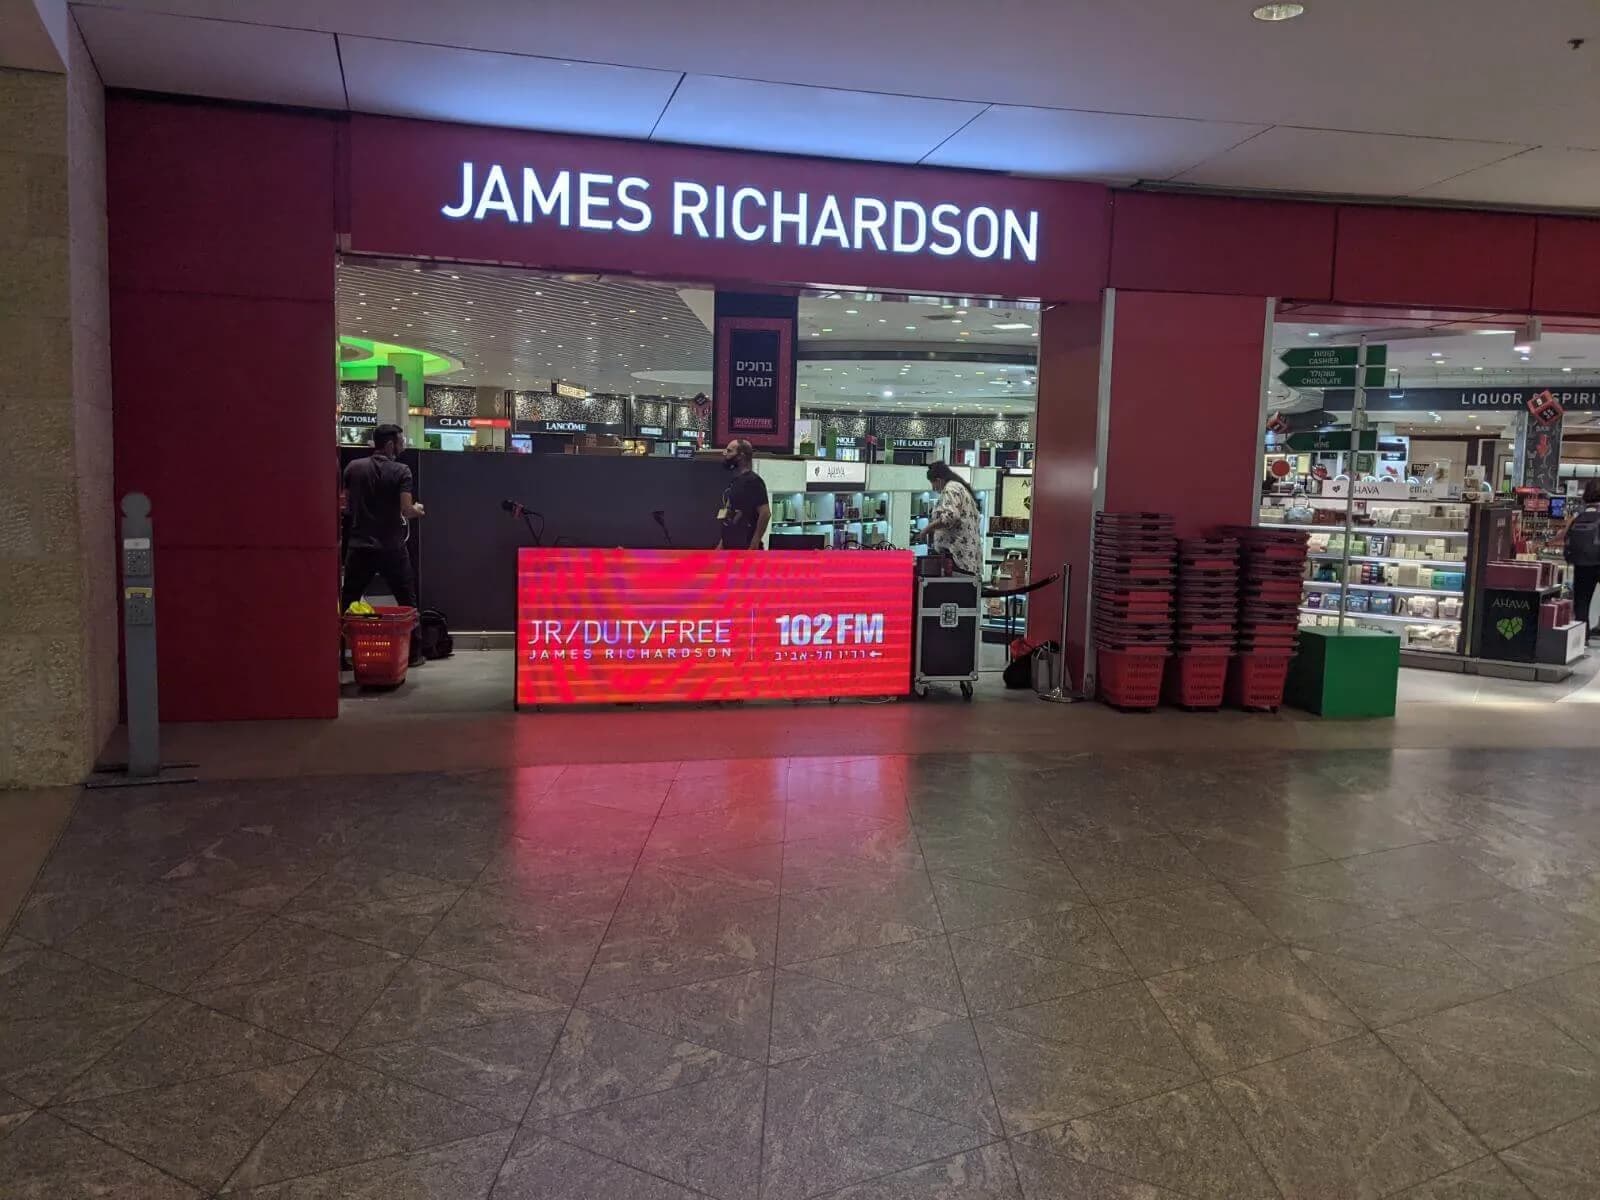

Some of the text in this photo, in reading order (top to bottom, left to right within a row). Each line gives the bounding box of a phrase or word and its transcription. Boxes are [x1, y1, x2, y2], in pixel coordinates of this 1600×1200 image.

[441, 161, 1040, 262] JAMES RICHARDSON
[736, 360, 773, 372] ברוכים
[1308, 357, 1340, 366] CASHIER
[736, 376, 773, 387] הבאים
[1301, 377, 1342, 386] CHOCOLATE
[1461, 393, 1523, 405] LIQUOR
[1551, 392, 1600, 405] SPIRI
[1491, 597, 1531, 611] AHAVA
[529, 647, 732, 660] JAMES RICHARDSON
[775, 650, 866, 661] רדיו תל-אביב
